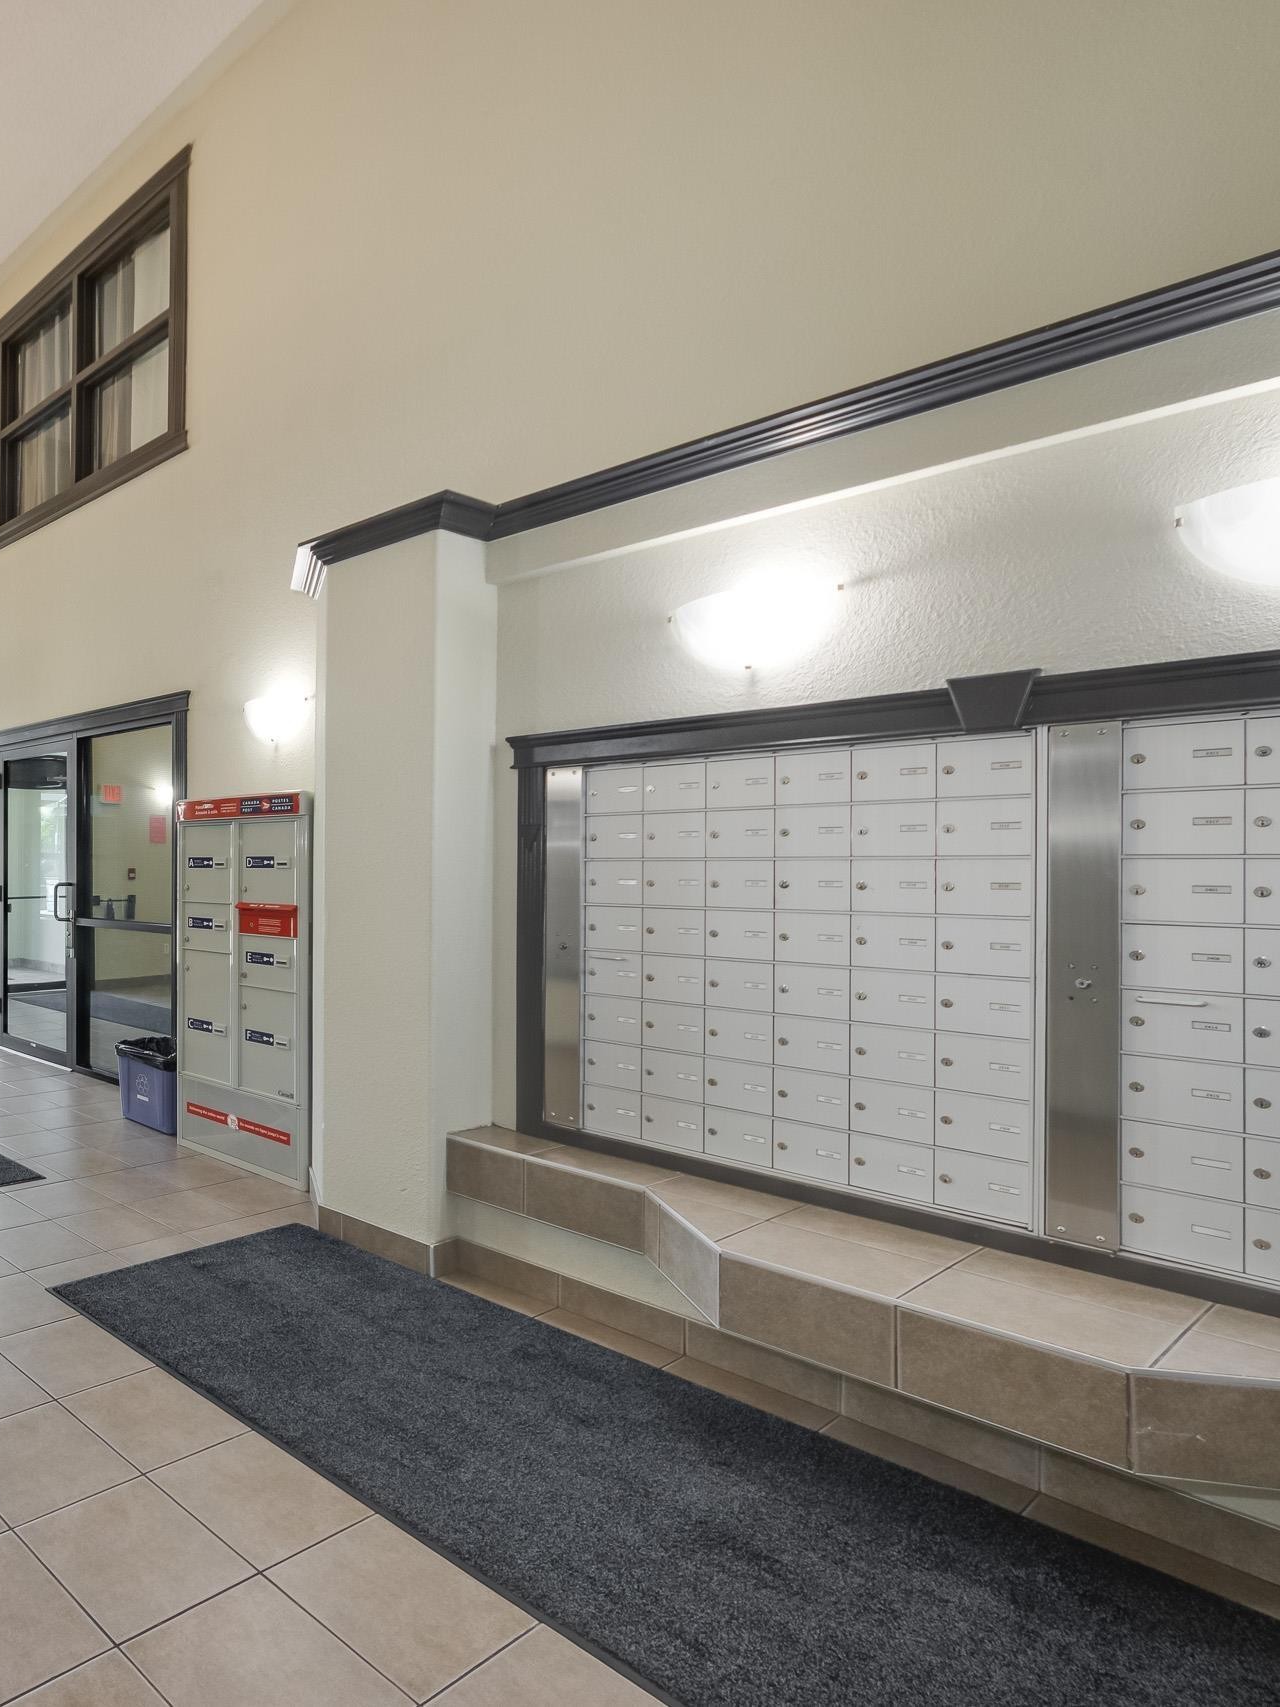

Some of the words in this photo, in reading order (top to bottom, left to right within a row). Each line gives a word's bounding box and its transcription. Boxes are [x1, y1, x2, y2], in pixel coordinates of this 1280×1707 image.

[188, 858, 194, 867] A
[246, 858, 253, 867] D
[188, 919, 193, 927] B
[247, 953, 252, 962] E
[188, 1019, 194, 1028] C
[246, 1031, 251, 1039] F
